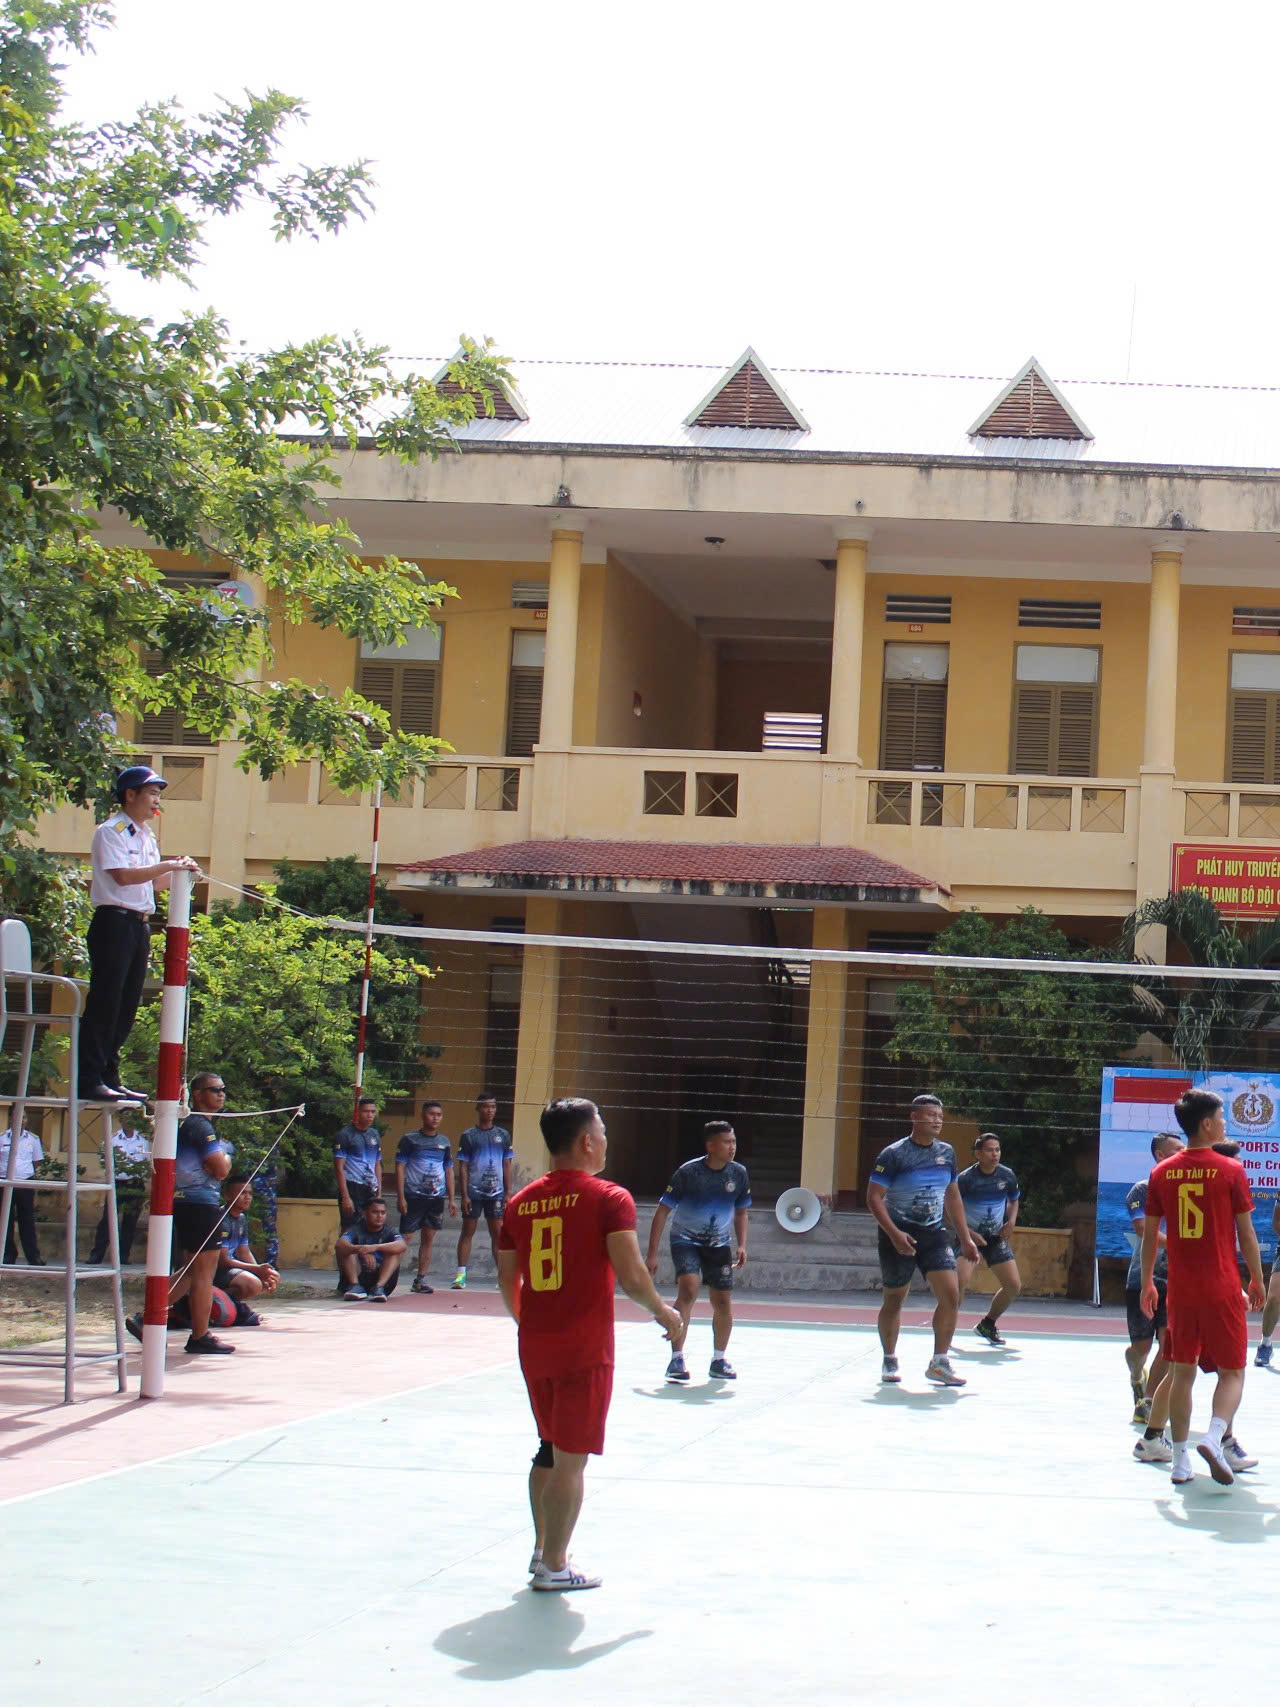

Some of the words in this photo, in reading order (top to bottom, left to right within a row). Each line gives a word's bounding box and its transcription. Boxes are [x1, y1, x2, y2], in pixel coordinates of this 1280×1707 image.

[1197, 856, 1222, 876] PHÁT
[1225, 860, 1244, 876] HUY
[1212, 887, 1239, 903] DANH
[1242, 885, 1254, 907] BỘ
[1257, 885, 1274, 908] ĐỘI
[1237, 1141, 1279, 1153] PORTS
[1165, 1169, 1184, 1180] CLB
[1206, 1168, 1218, 1179] 17
[1243, 1160, 1261, 1169] the
[1258, 1176, 1278, 1187] KRI
[517, 1200, 538, 1216] CLB
[565, 1193, 580, 1208] 17
[1178, 1183, 1204, 1239] 6
[529, 1216, 563, 1292] 8
